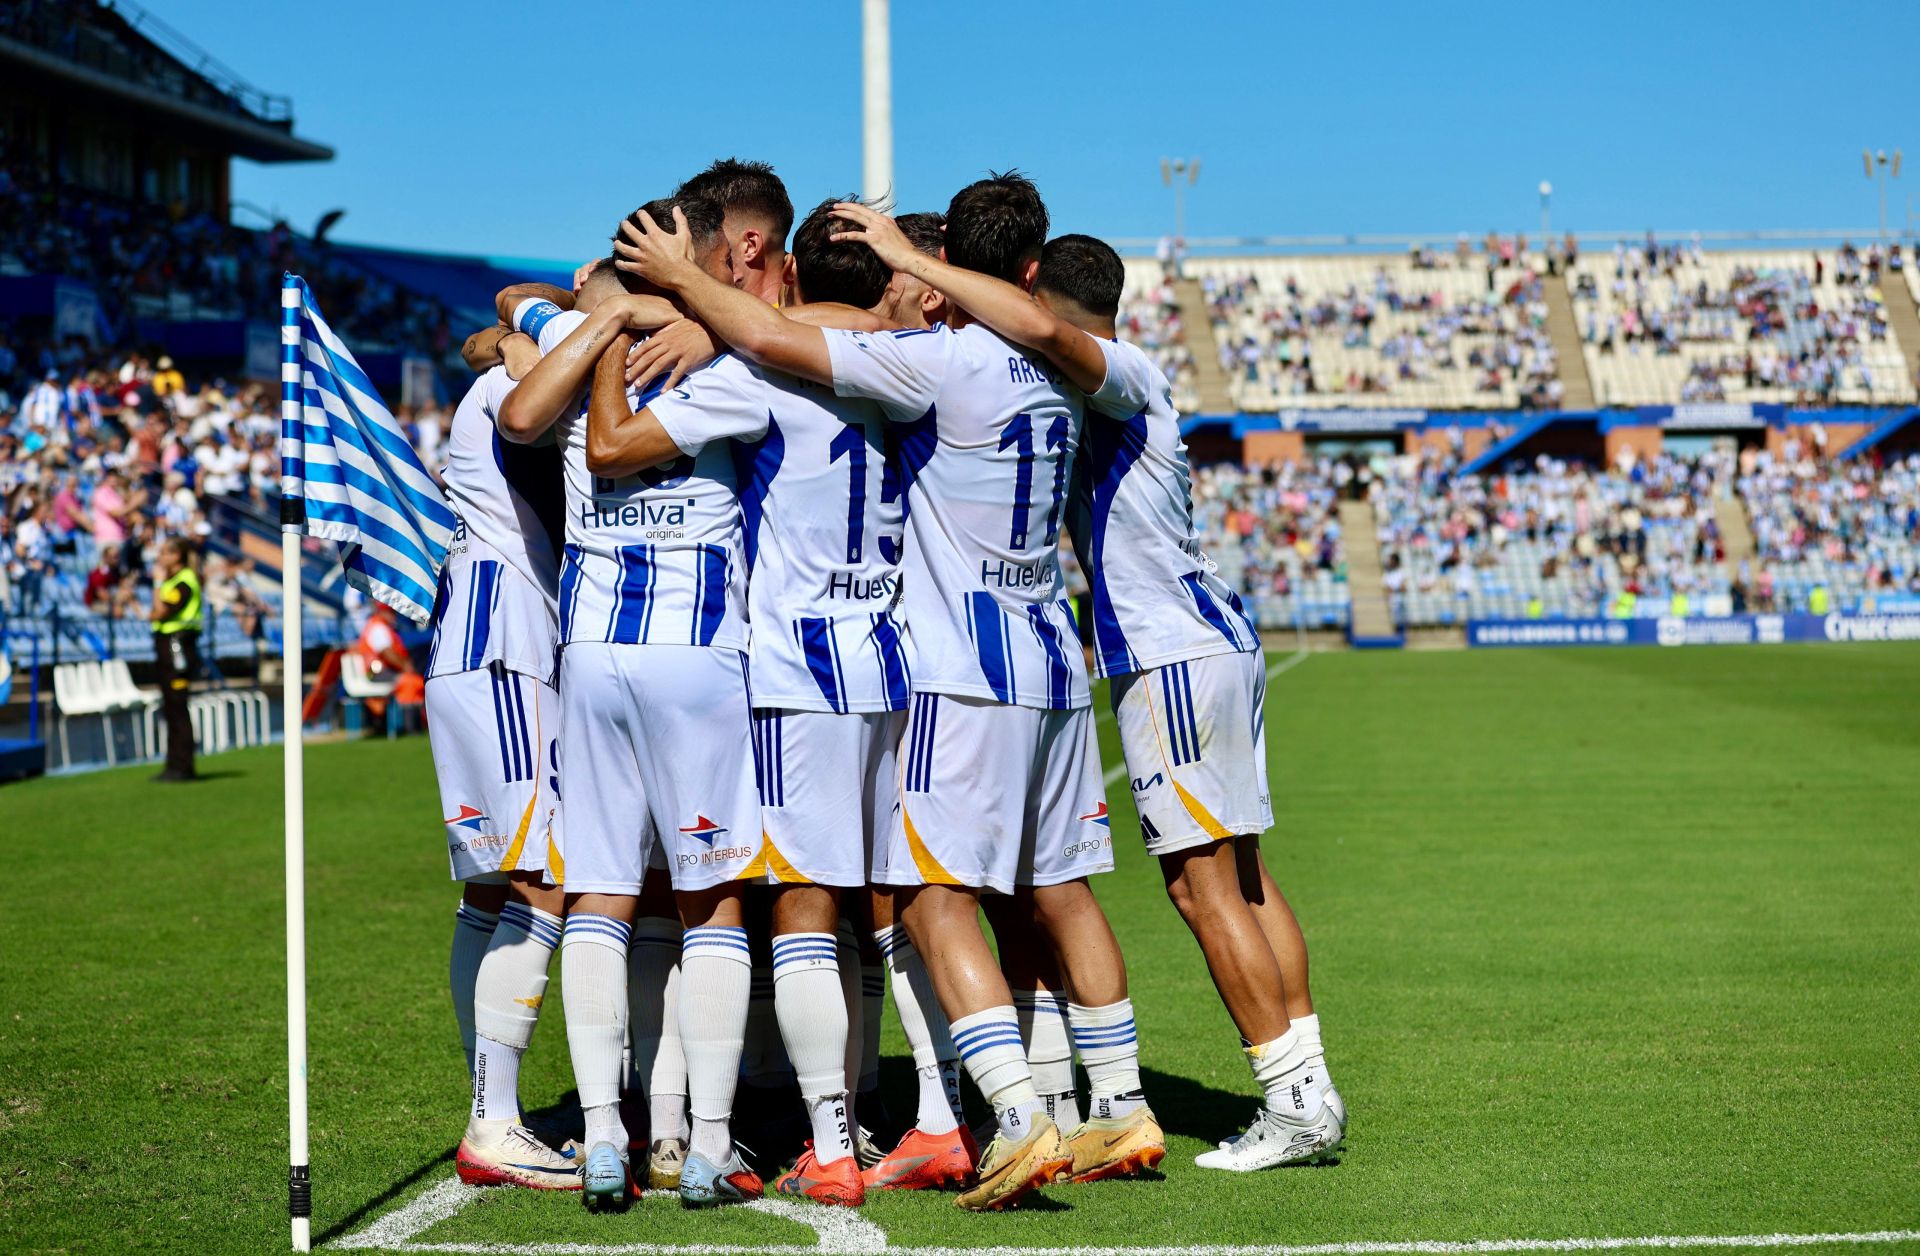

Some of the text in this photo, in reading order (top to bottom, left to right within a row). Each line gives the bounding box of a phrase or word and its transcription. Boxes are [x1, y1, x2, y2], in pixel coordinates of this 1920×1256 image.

[998, 413, 1069, 550] 11
[581, 499, 684, 529] Huelva
[645, 529, 684, 540] original
[702, 846, 752, 865] INTERBUS
[1063, 839, 1100, 857] GRUPO
[477, 1053, 487, 1109] TAPEDESIGN
[1007, 1107, 1021, 1127] CKS
